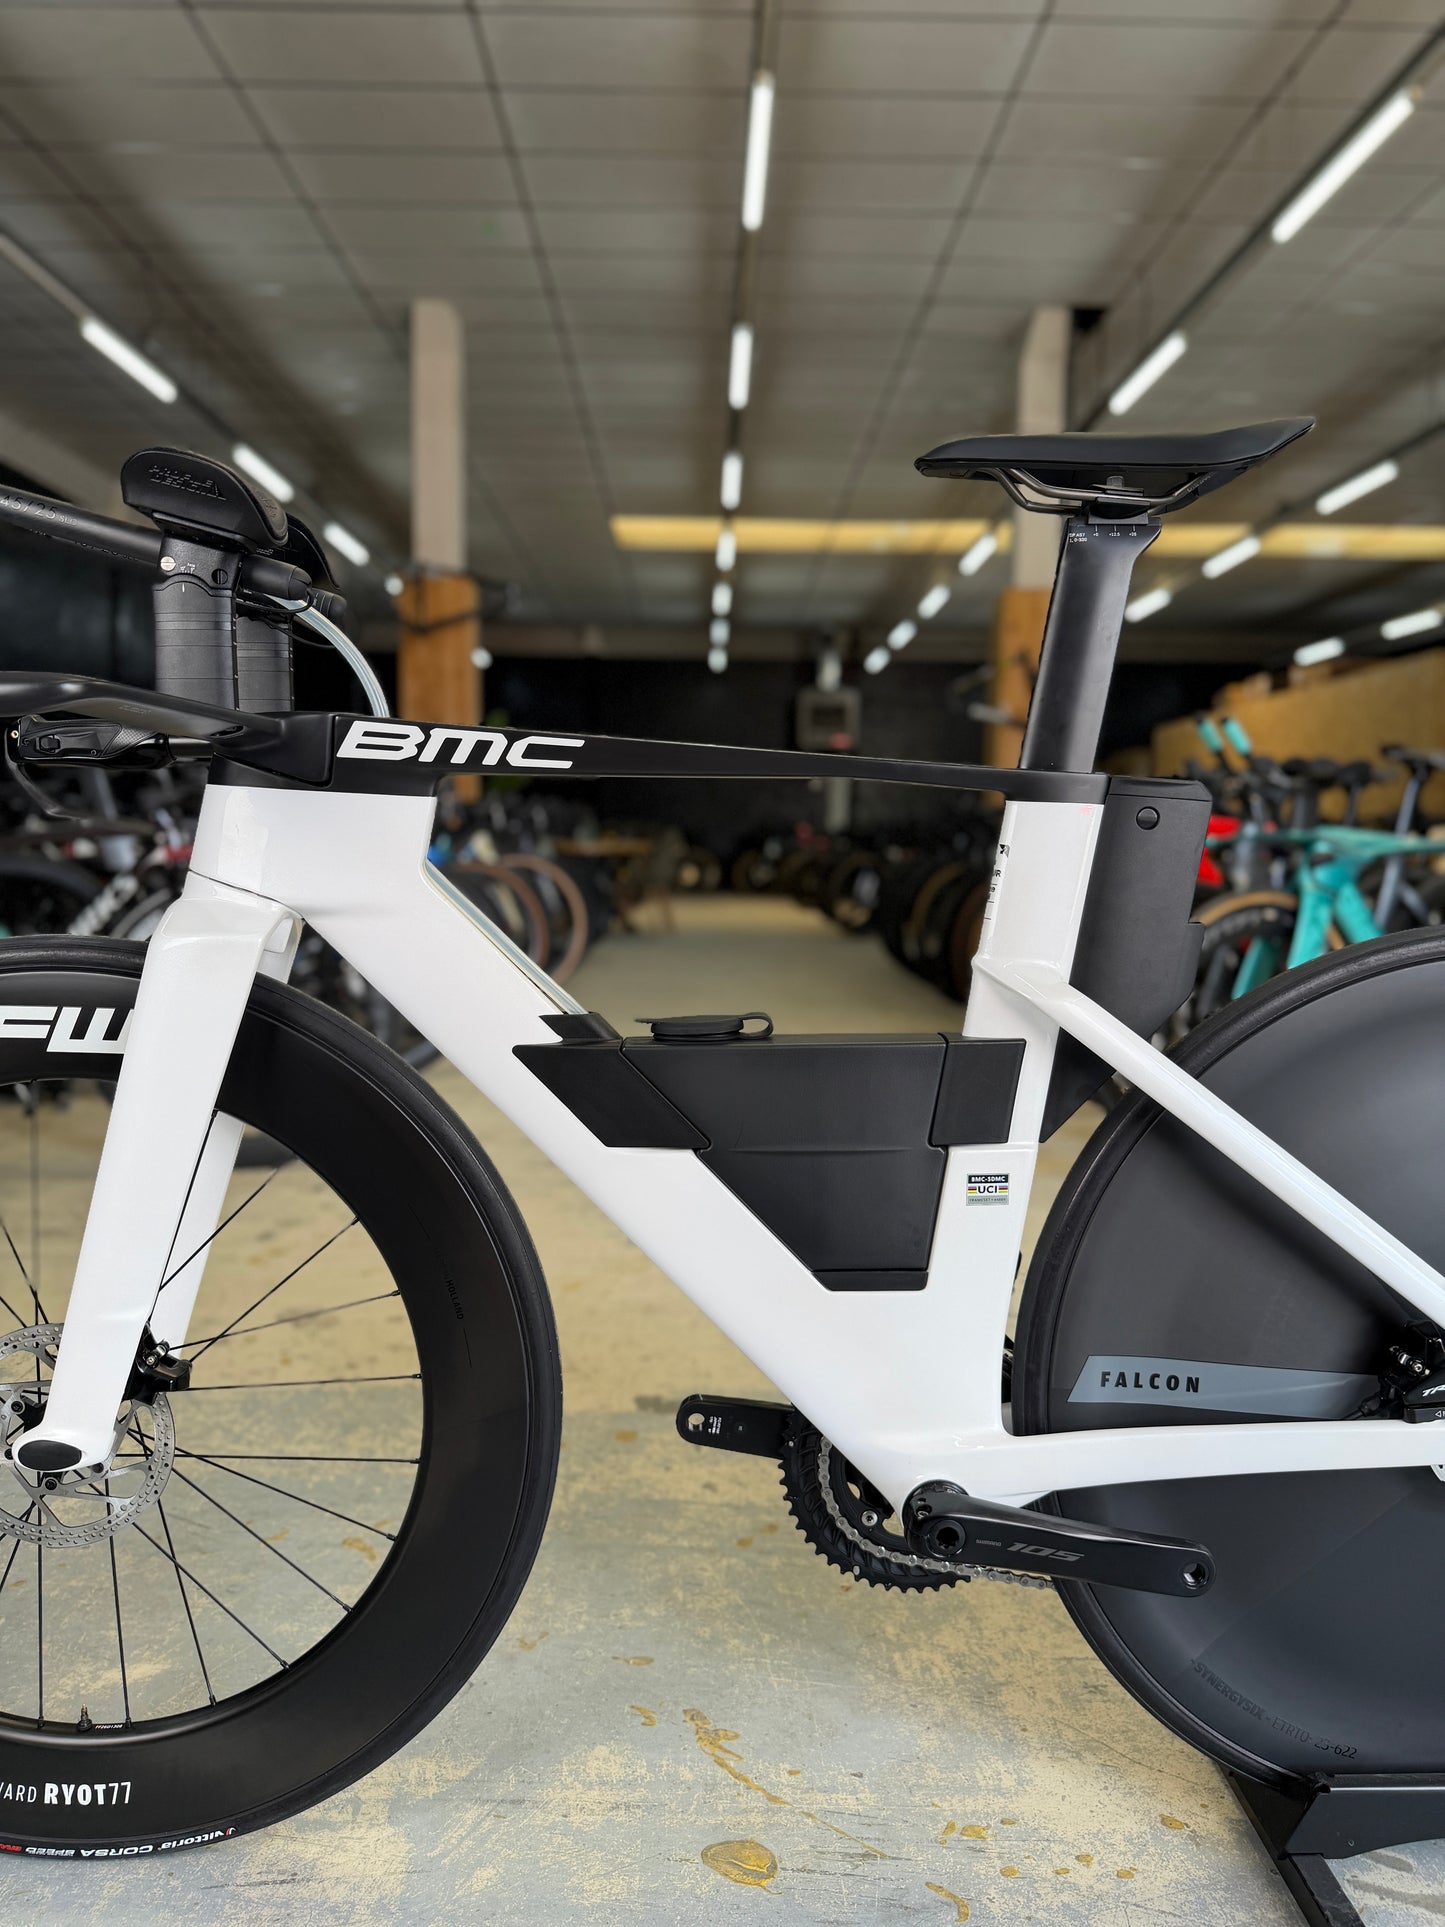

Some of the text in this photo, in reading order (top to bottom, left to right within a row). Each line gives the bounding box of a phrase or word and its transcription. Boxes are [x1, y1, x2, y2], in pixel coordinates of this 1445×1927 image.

[336, 720, 585, 769] BMC
[978, 1185, 997, 1193] UCI
[446, 1279, 465, 1320] HOLLAND
[1100, 1371, 1200, 1393] FALCON
[1006, 1541, 1085, 1562] 105
[0, 1782, 37, 1804] ARD
[80, 1845, 154, 1858] CORSA
